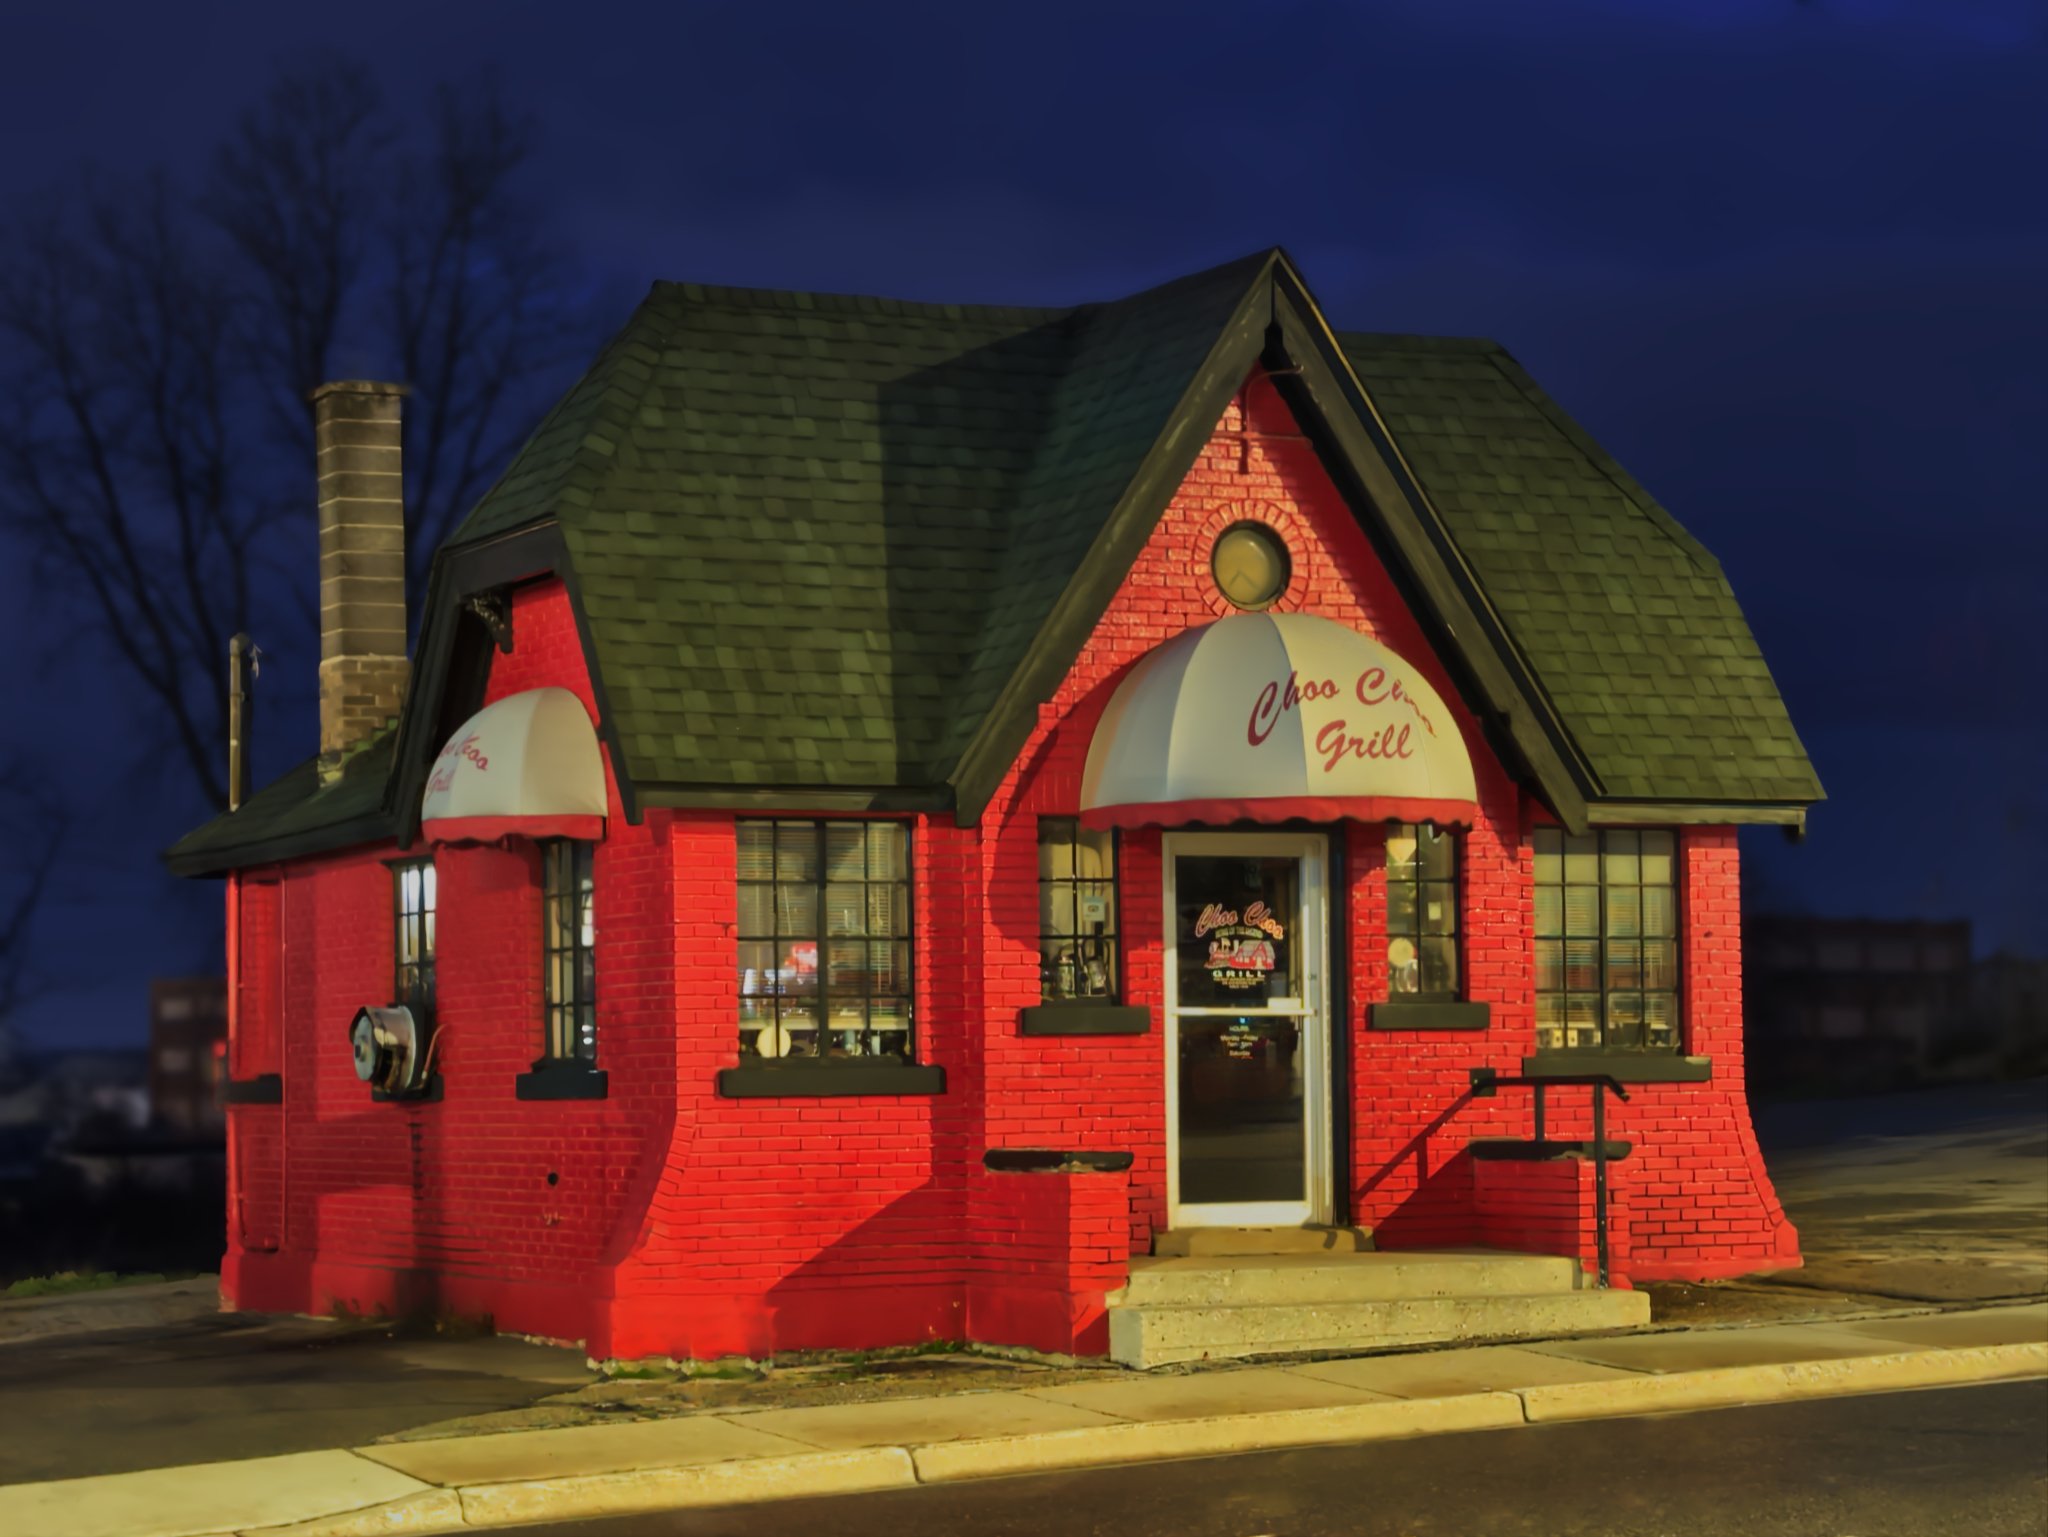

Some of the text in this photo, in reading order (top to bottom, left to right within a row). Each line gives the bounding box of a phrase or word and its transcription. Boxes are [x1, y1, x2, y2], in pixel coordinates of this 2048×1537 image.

[1248, 670, 1340, 747] Choo
[1315, 719, 1414, 773] Grill
[1196, 901, 1283, 939] Choo Choo
[1212, 970, 1265, 978] GRILL
